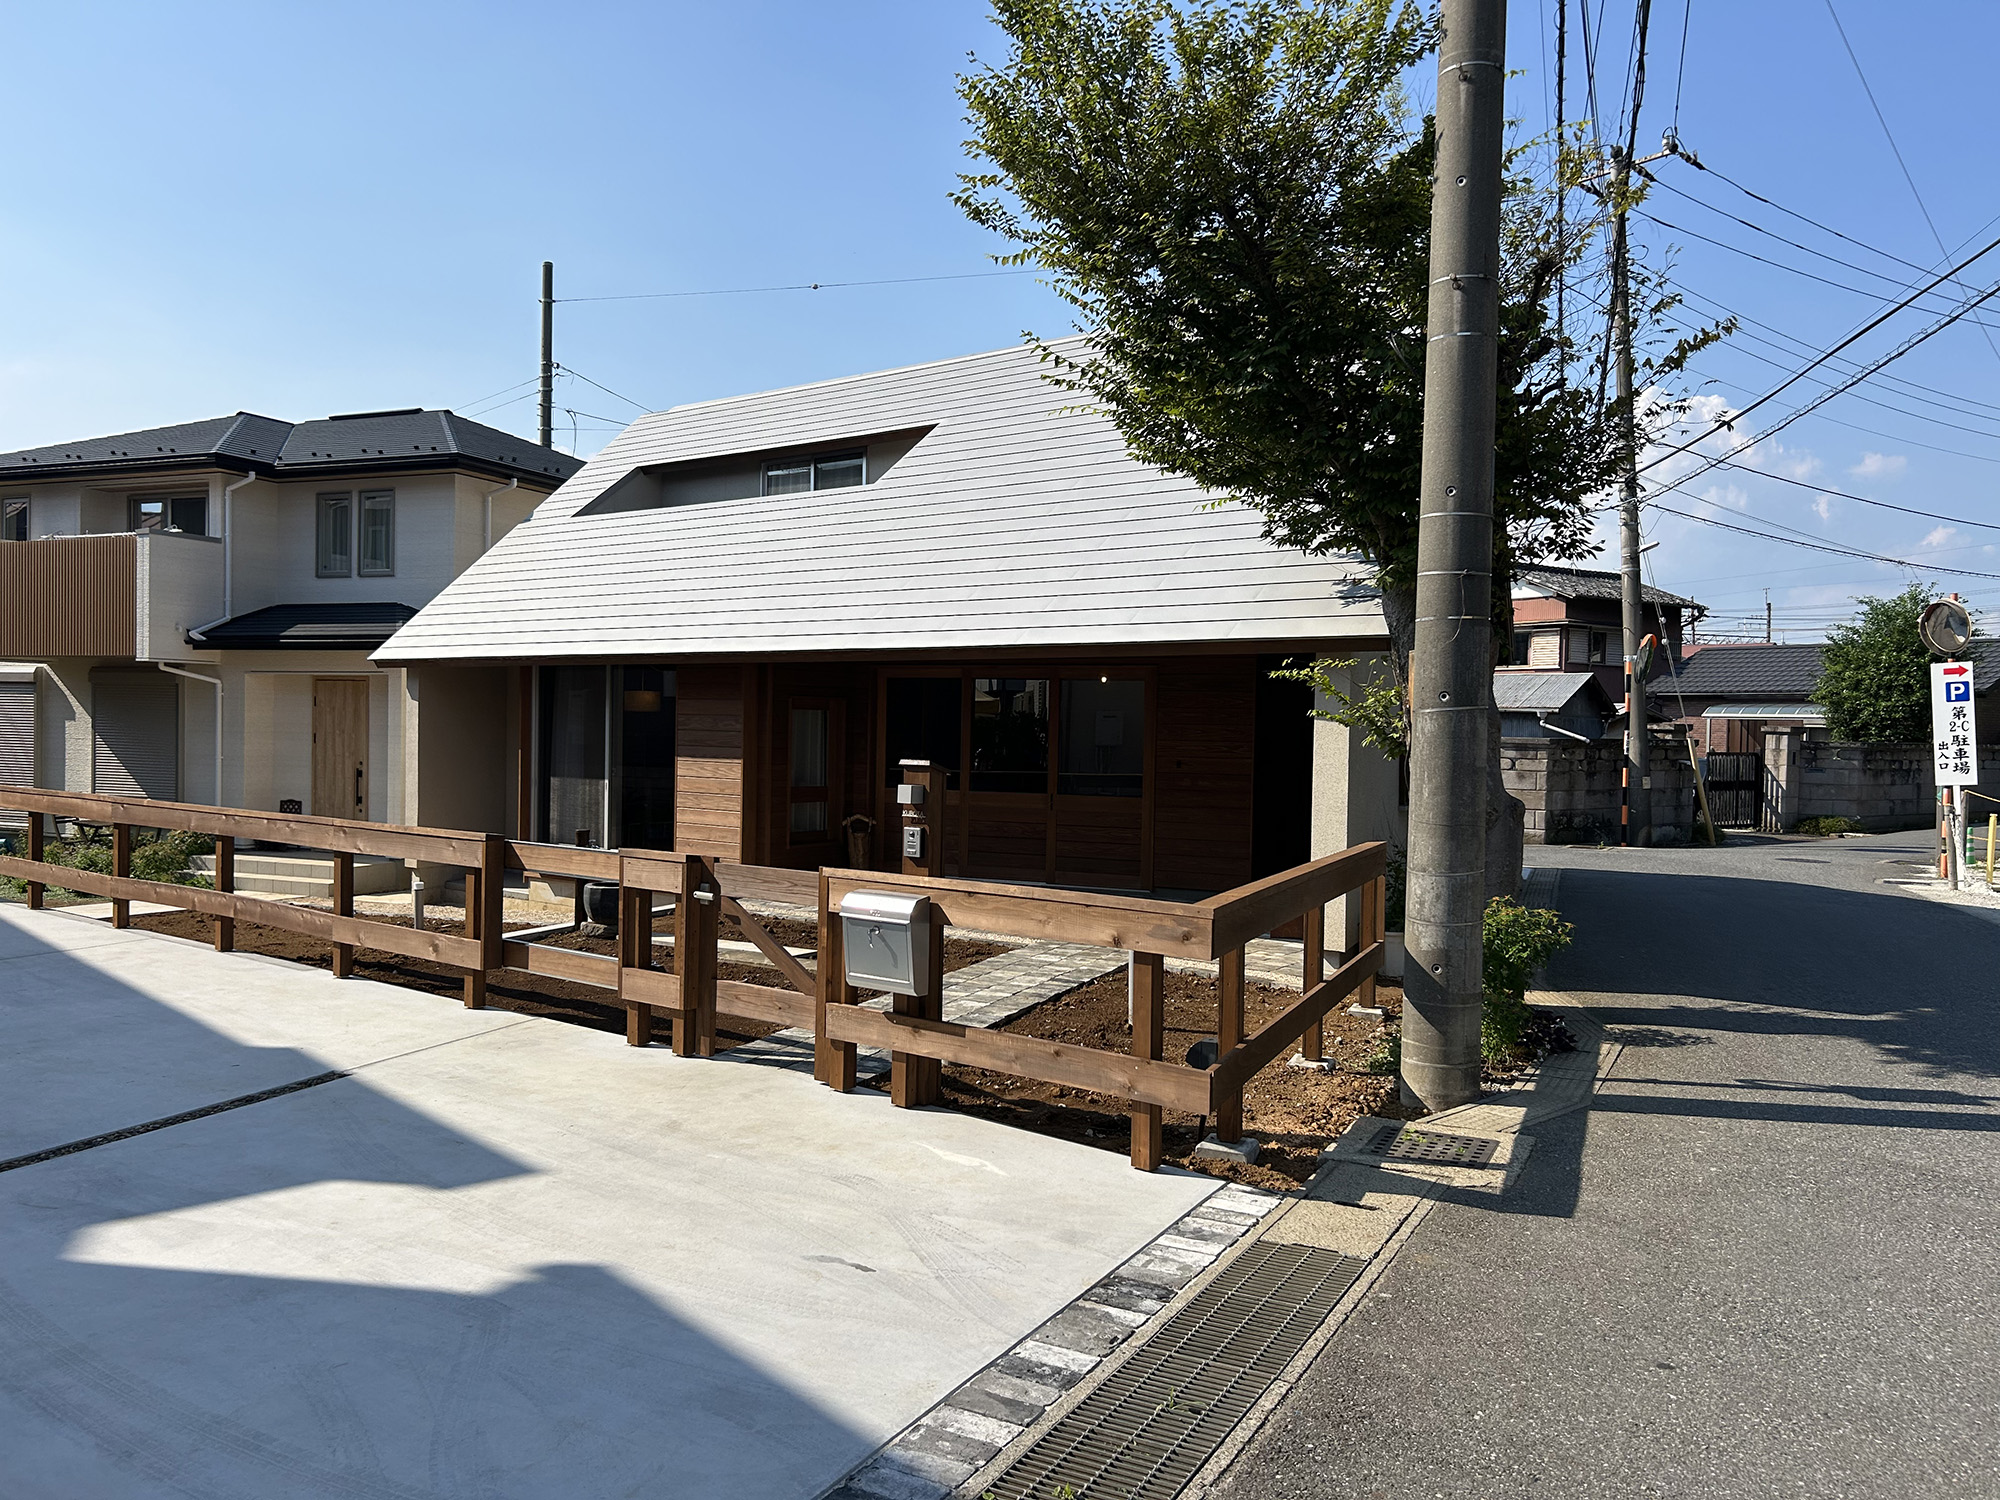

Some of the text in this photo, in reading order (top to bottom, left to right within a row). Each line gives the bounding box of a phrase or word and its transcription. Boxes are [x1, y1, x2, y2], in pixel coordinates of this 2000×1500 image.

[1950, 683, 1966, 701] P
[1938, 741, 1950, 770] 出入口
